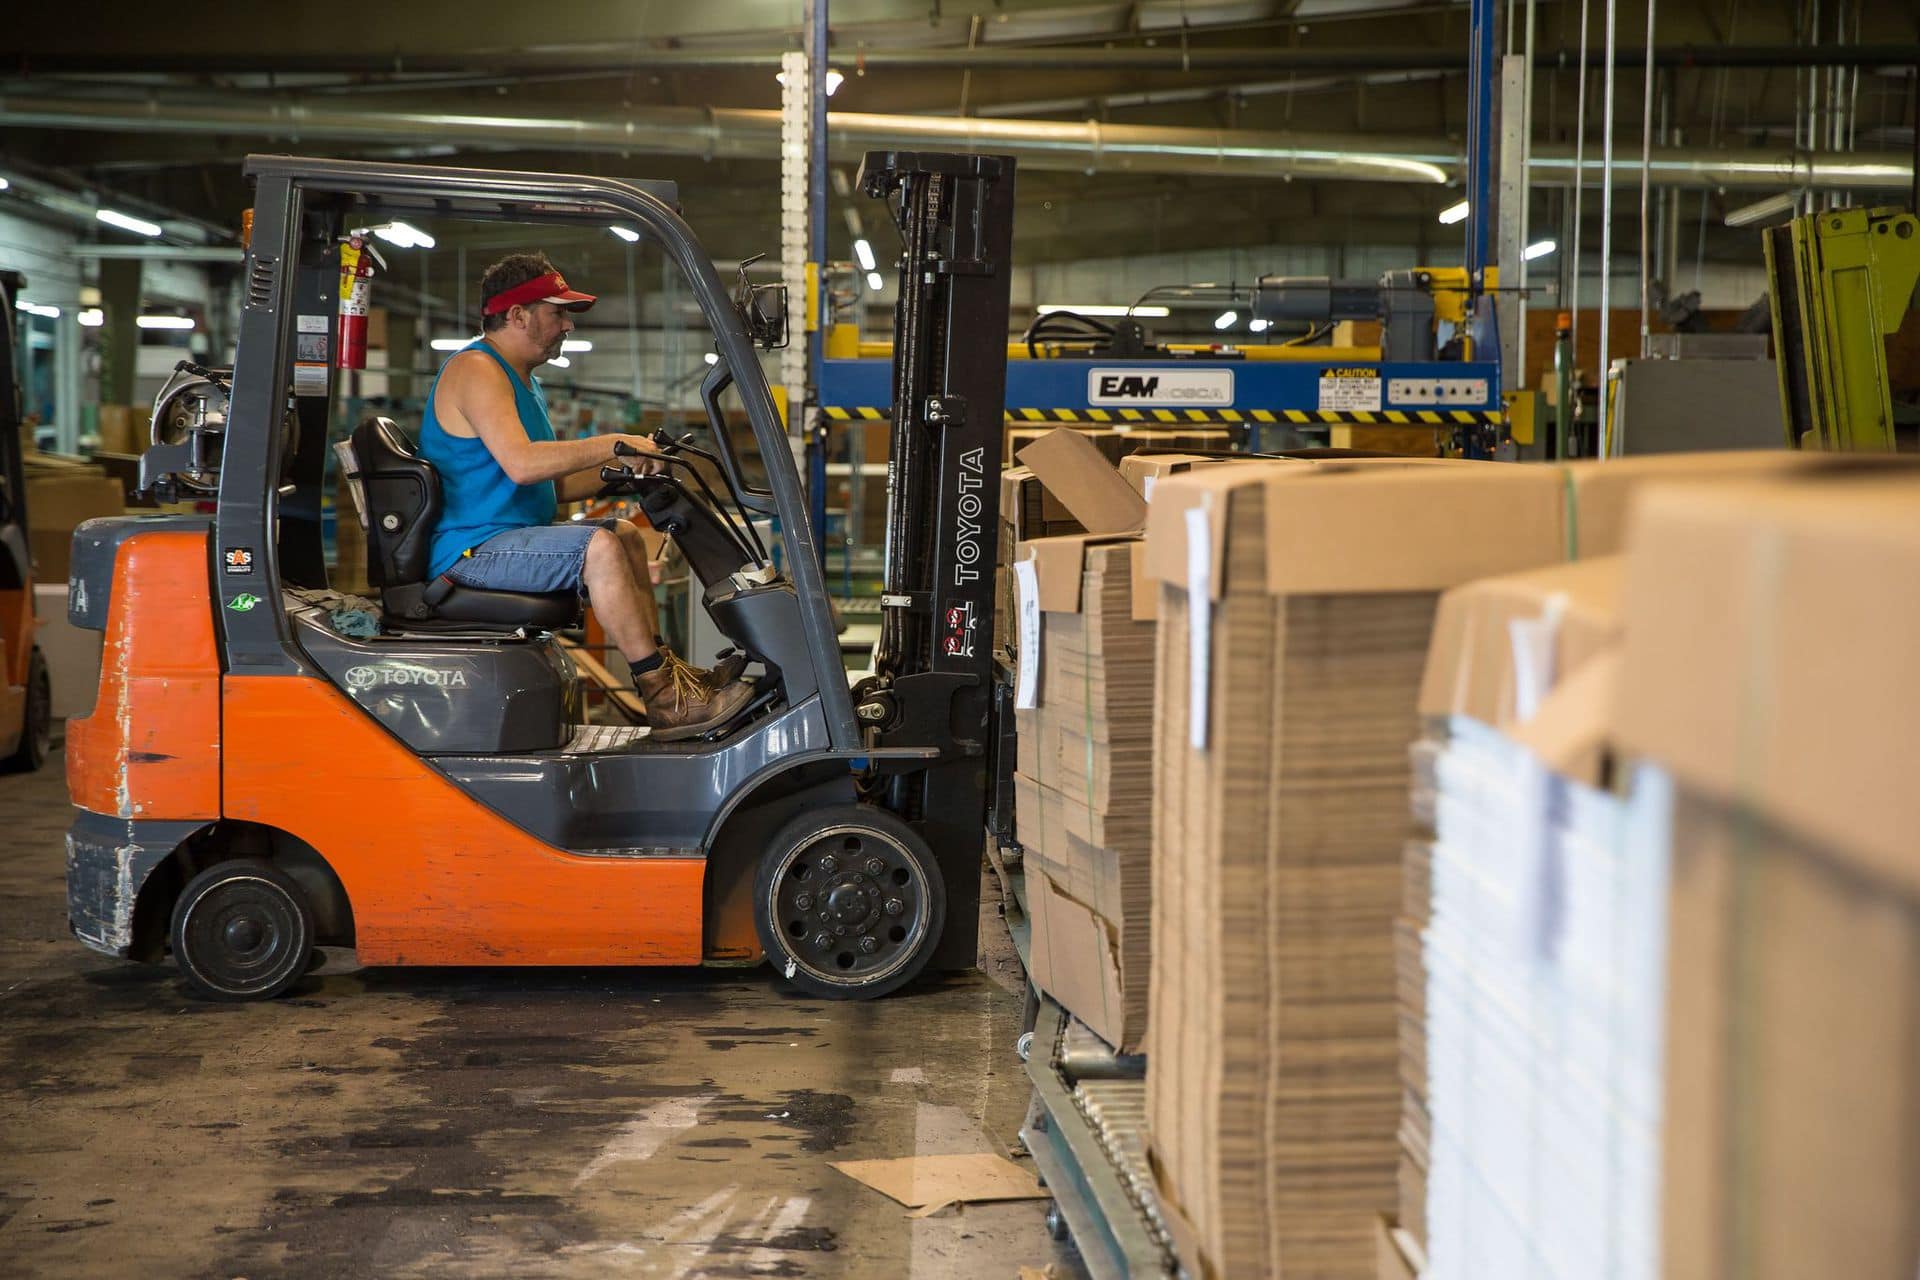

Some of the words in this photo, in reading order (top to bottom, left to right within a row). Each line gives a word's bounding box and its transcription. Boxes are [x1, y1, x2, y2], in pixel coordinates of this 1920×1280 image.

[1336, 368, 1377, 378] CAUTION
[1099, 376, 1159, 398] EAM
[955, 447, 984, 586] TOYOTA
[226, 549, 252, 565] SAS
[381, 669, 467, 686] TOYOTA
